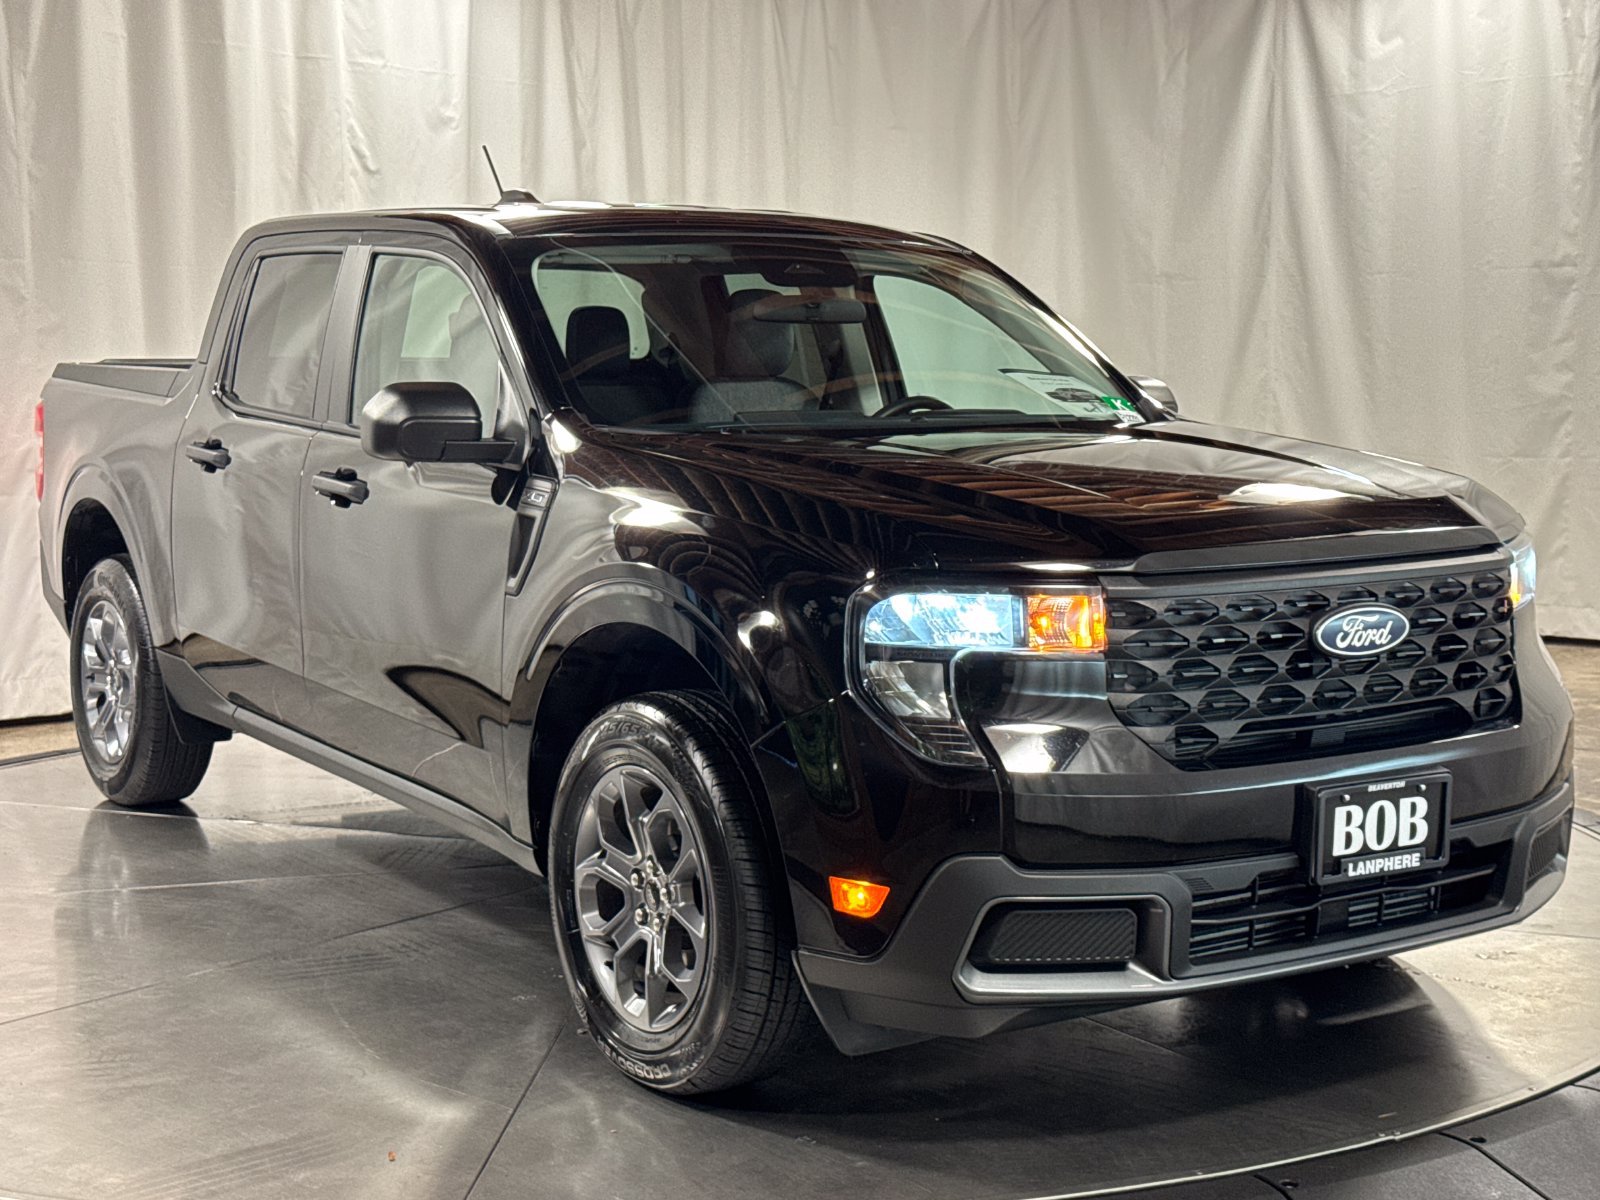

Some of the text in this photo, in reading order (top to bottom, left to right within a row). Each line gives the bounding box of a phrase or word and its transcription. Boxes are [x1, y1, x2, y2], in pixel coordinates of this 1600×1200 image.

[1336, 614, 1392, 648] Ford
[1368, 781, 1406, 792] BEAVERTON
[1332, 796, 1428, 857] BOB
[1347, 852, 1421, 877] LANPHERE
